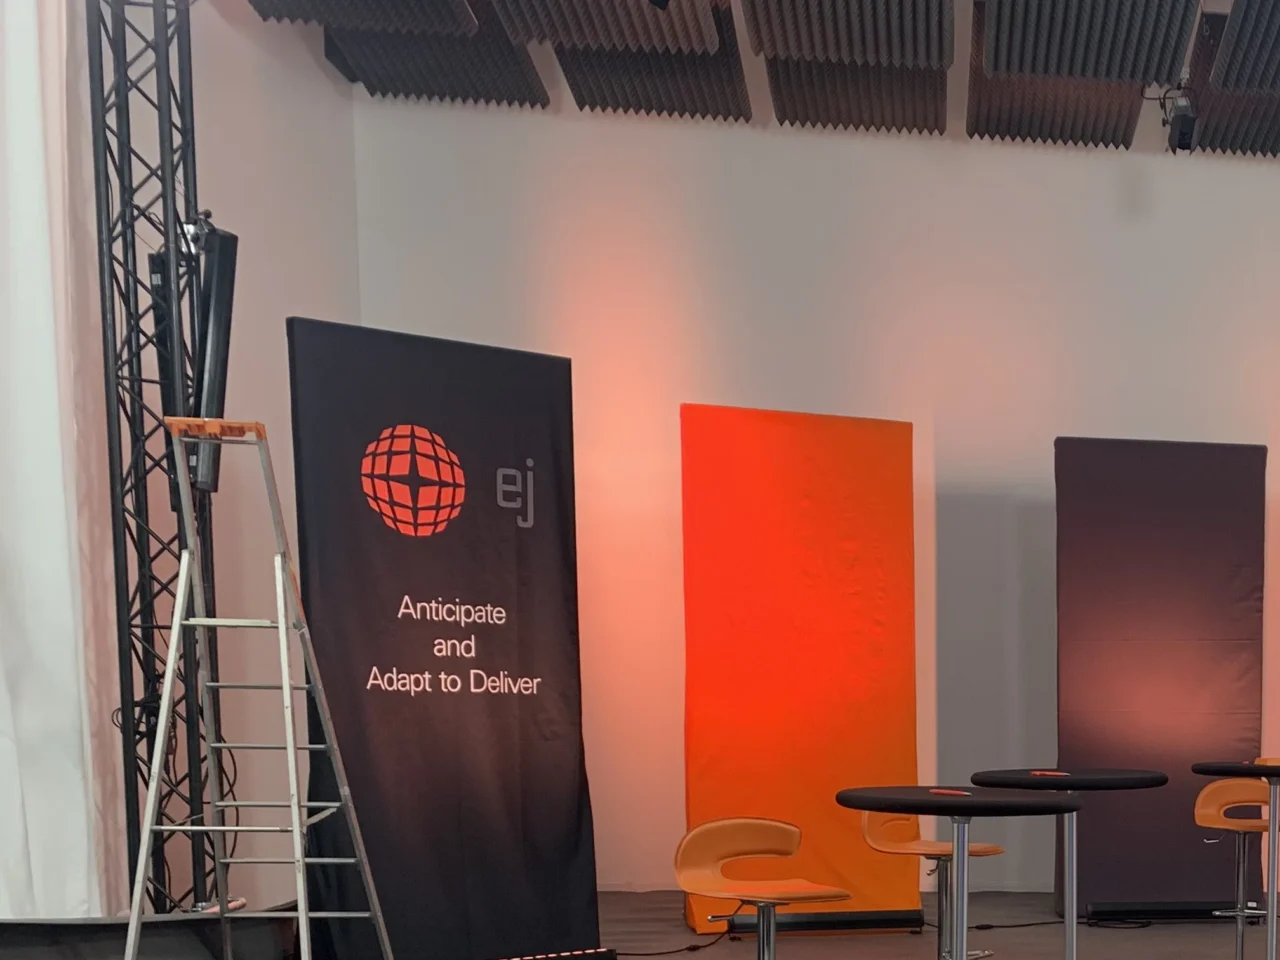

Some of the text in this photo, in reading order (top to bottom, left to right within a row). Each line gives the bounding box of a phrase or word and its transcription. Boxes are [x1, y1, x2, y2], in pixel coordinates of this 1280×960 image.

[496, 458, 534, 528] ej
[398, 595, 506, 627] Anticipate
[433, 635, 476, 658] and
[366, 666, 542, 697] Adapt to Deliver
